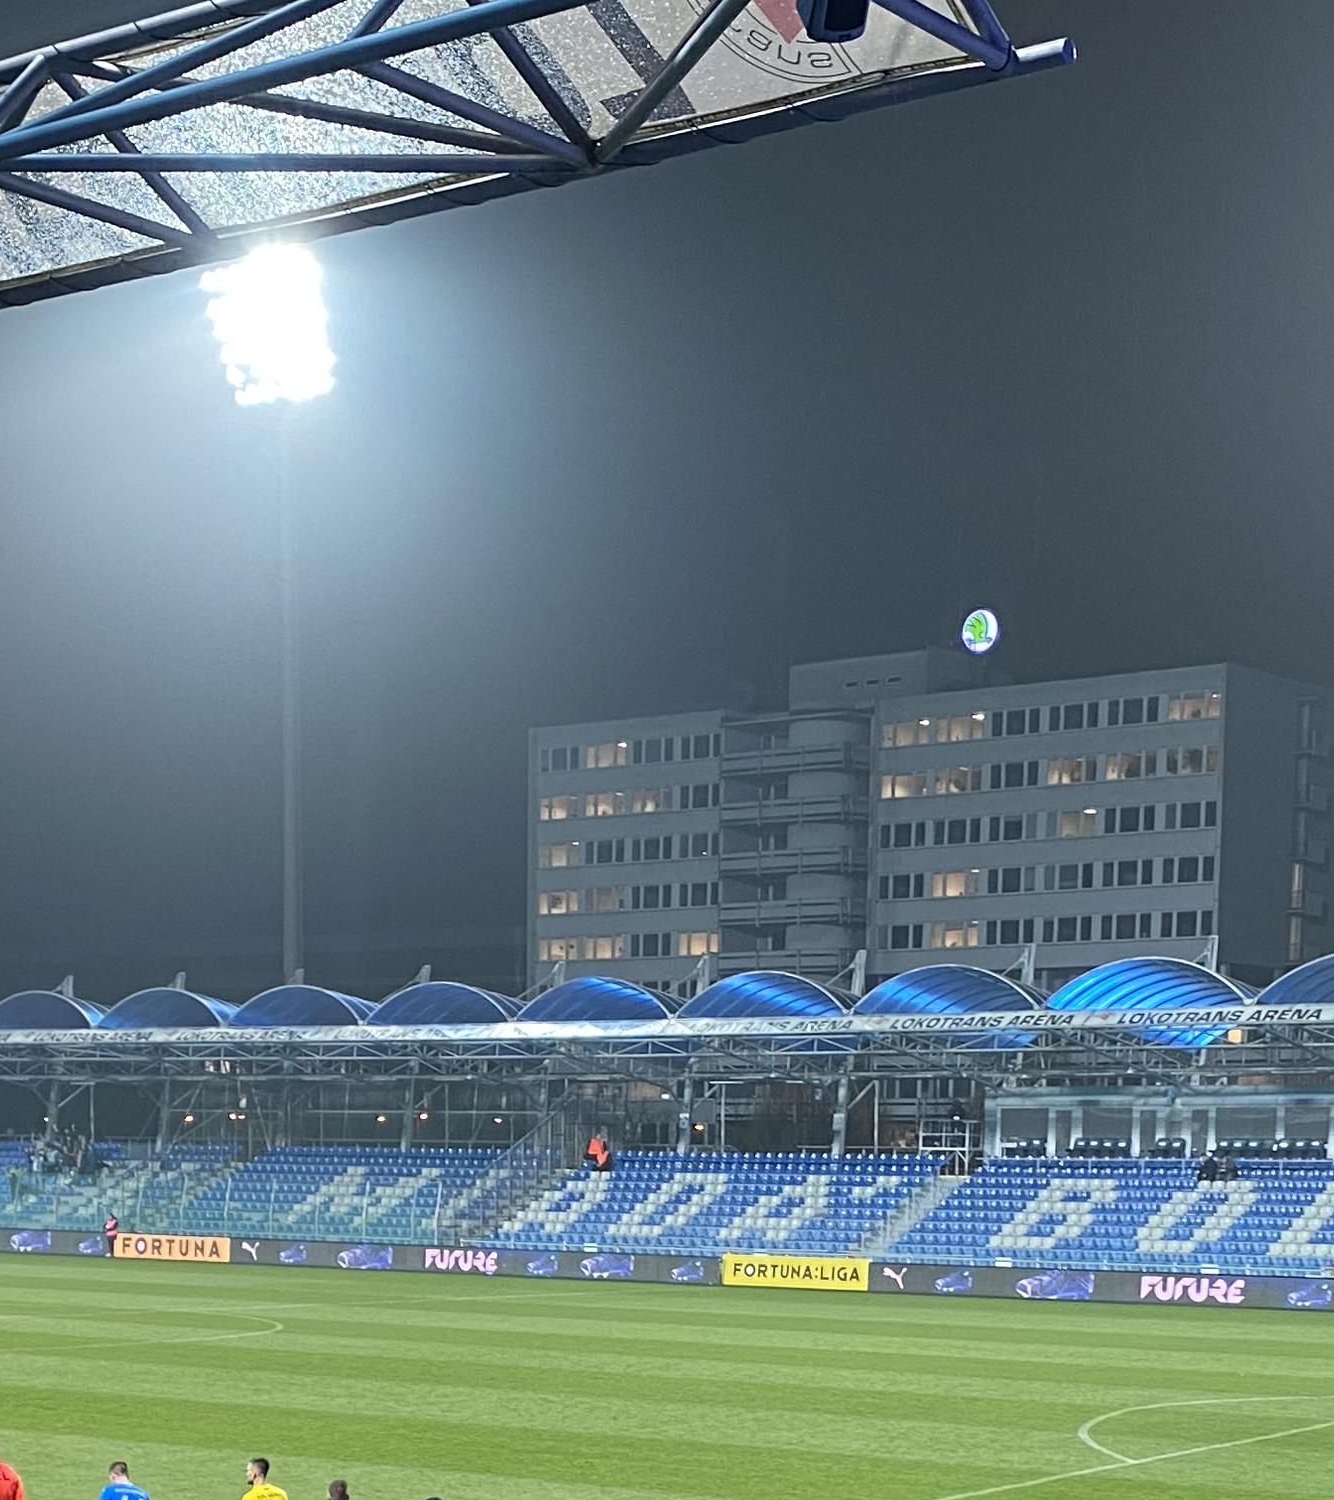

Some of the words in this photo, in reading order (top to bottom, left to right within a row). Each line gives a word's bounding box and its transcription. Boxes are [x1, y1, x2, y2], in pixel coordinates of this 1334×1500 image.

[889, 1016, 1004, 1030] LOKOTRANS
[1117, 1009, 1244, 1025] LOKOTRANS
[122, 1237, 221, 1258] FORTUNA
[425, 1248, 498, 1273] FUTURE
[1139, 1274, 1246, 1304] FUTURE
